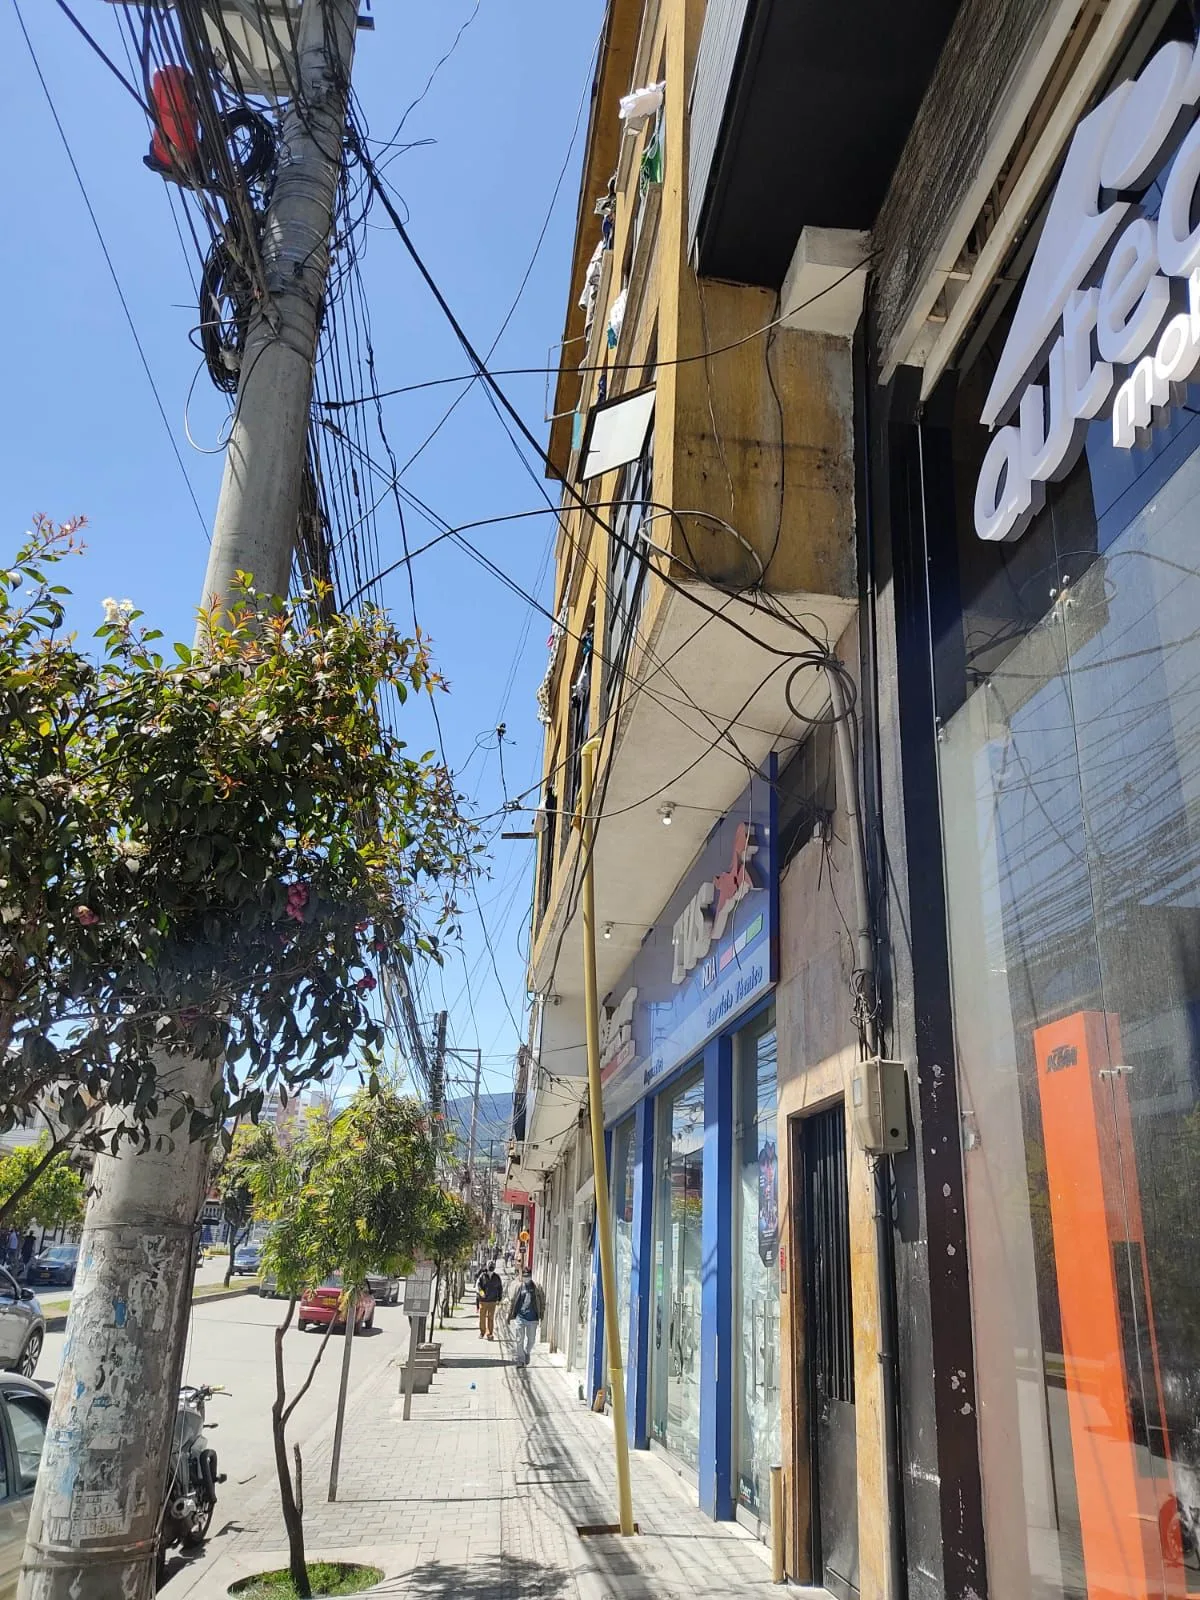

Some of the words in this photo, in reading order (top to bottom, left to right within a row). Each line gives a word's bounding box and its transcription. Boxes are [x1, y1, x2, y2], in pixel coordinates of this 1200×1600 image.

[1112, 267, 1200, 449] mo
[671, 881, 715, 985] TVS
[1047, 1044, 1078, 1073] KTM
